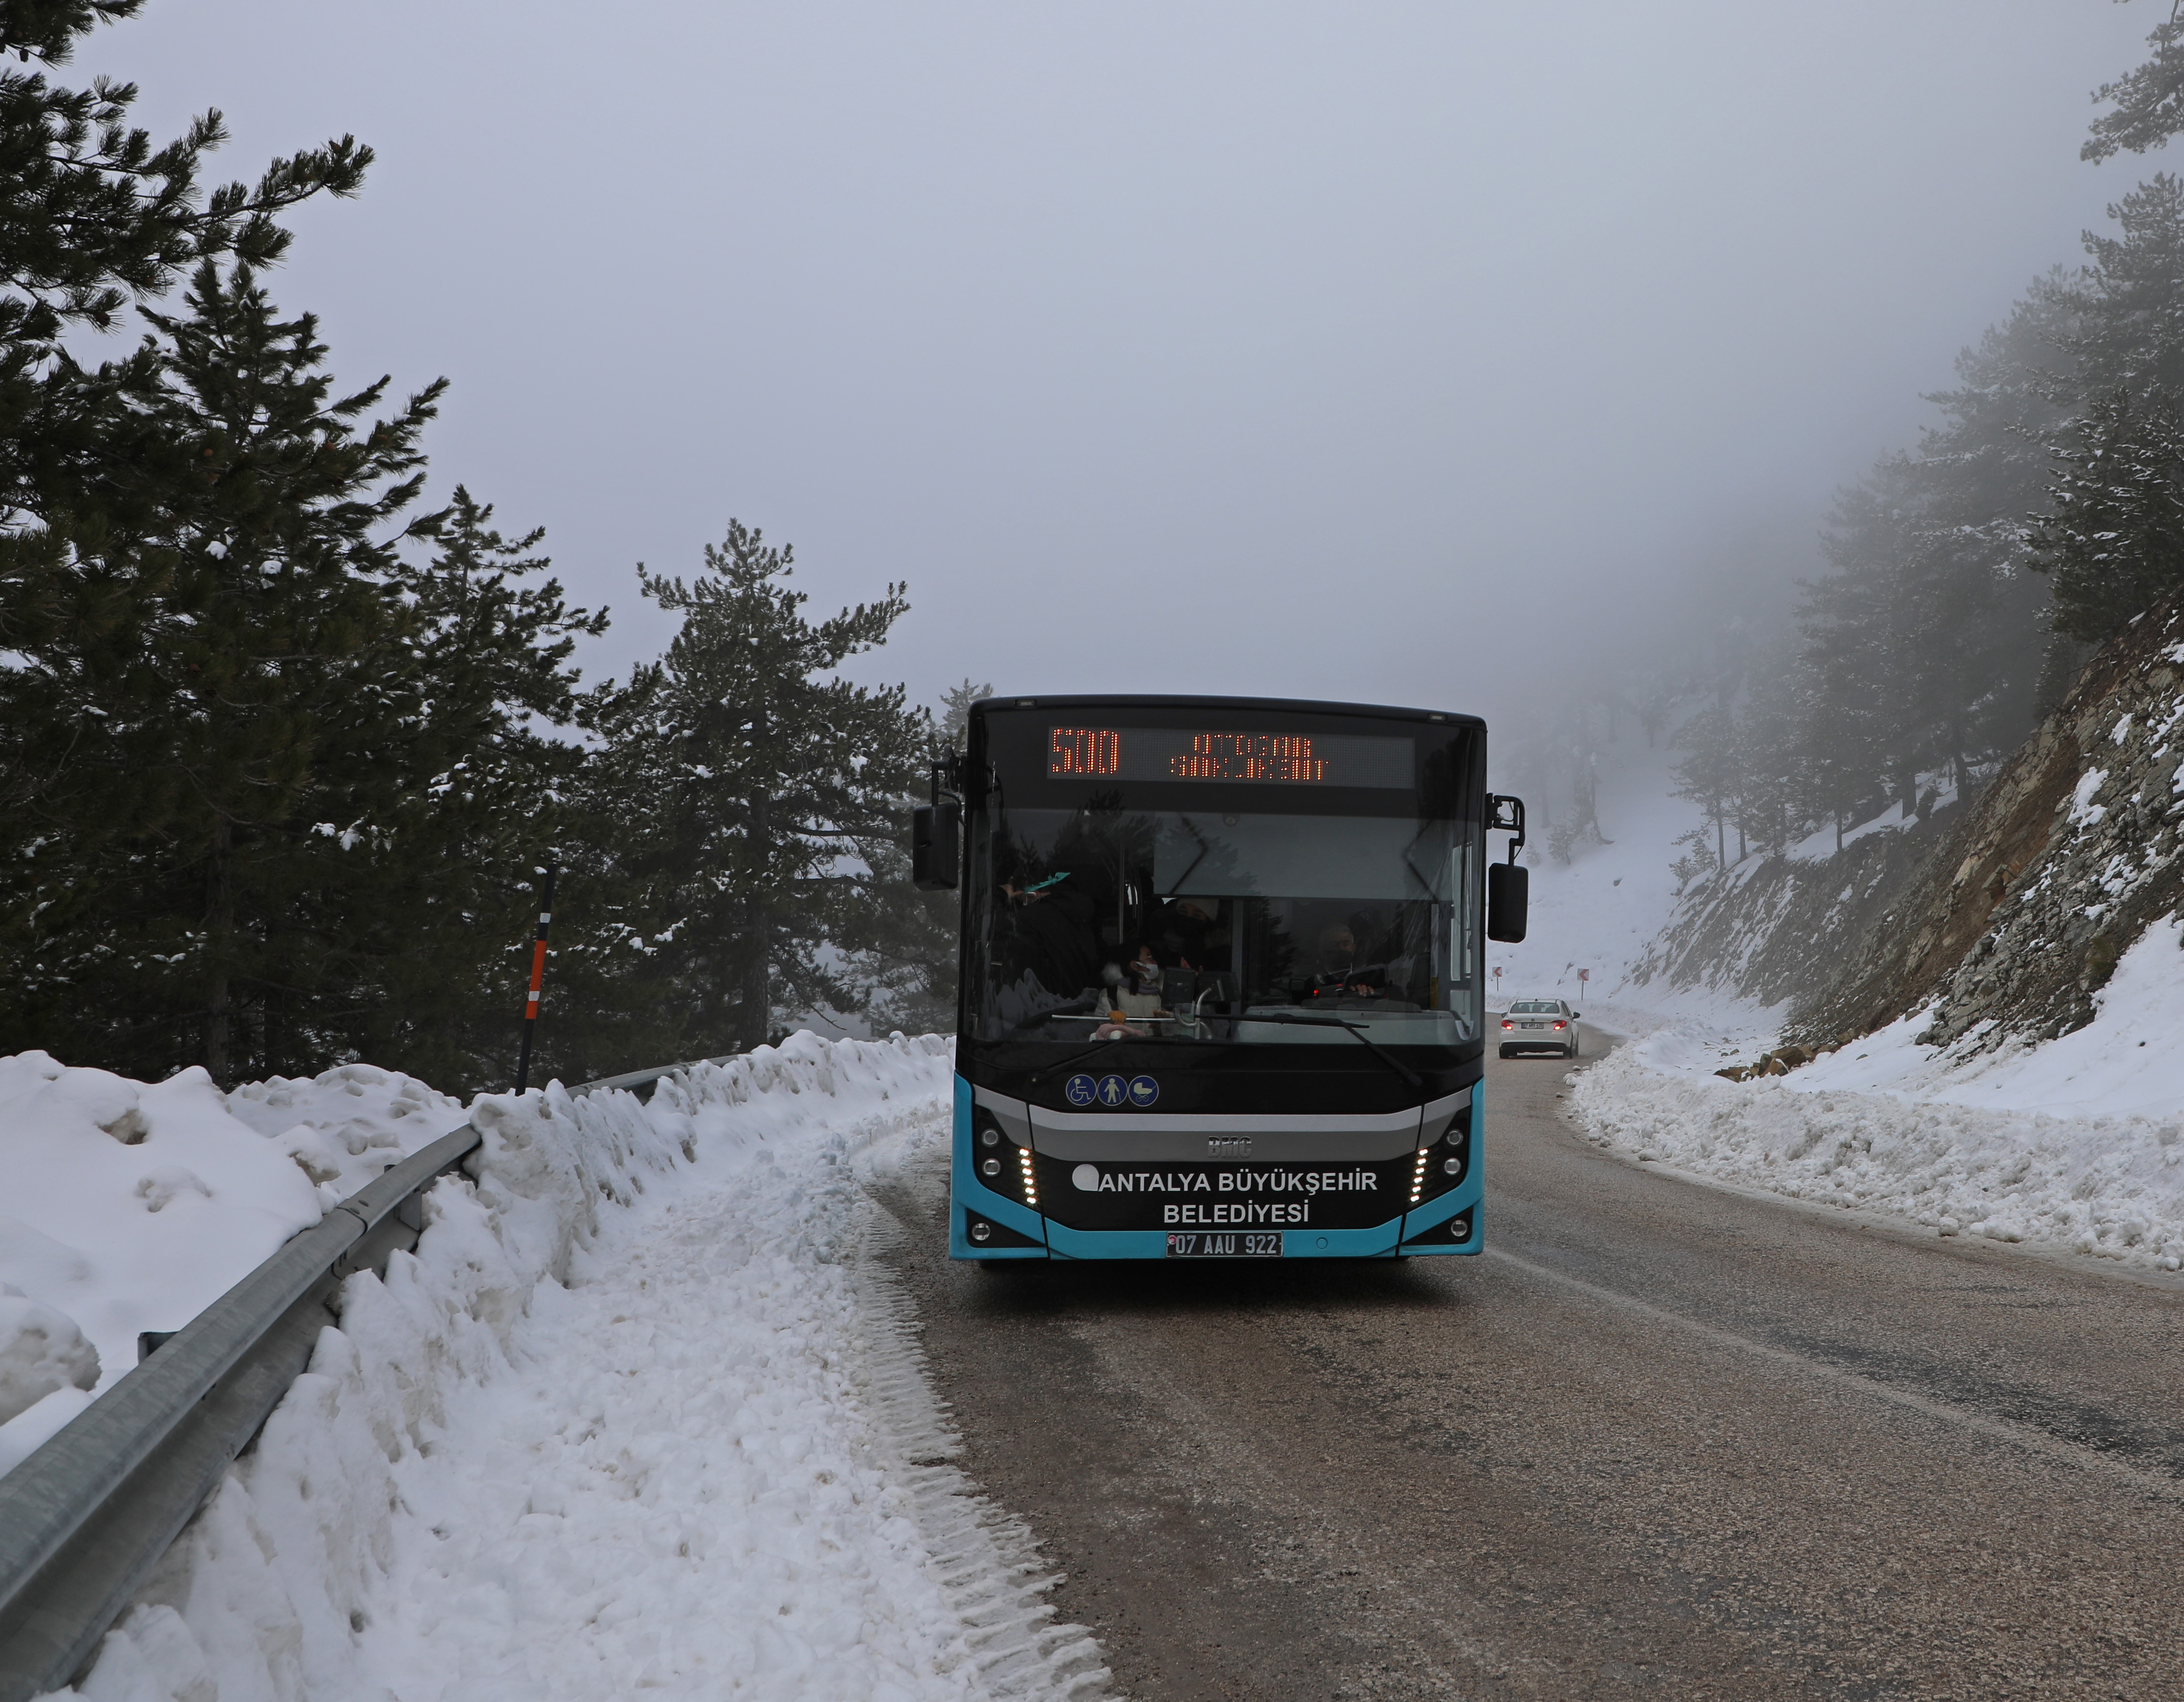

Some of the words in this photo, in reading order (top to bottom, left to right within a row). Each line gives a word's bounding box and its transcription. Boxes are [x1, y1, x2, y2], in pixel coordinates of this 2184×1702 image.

[1052, 729, 1119, 774] 500
[1208, 1136, 1252, 1158] BMC
[1098, 1173, 1211, 1192] ANTALYA
[1219, 1168, 1378, 1195] BÜYÜKŞEHİR
[1164, 1199, 1309, 1223] BELEDİYESİ
[1176, 1235, 1197, 1254] 07
[1204, 1235, 1235, 1254] AAU
[1246, 1235, 1277, 1254] 922
